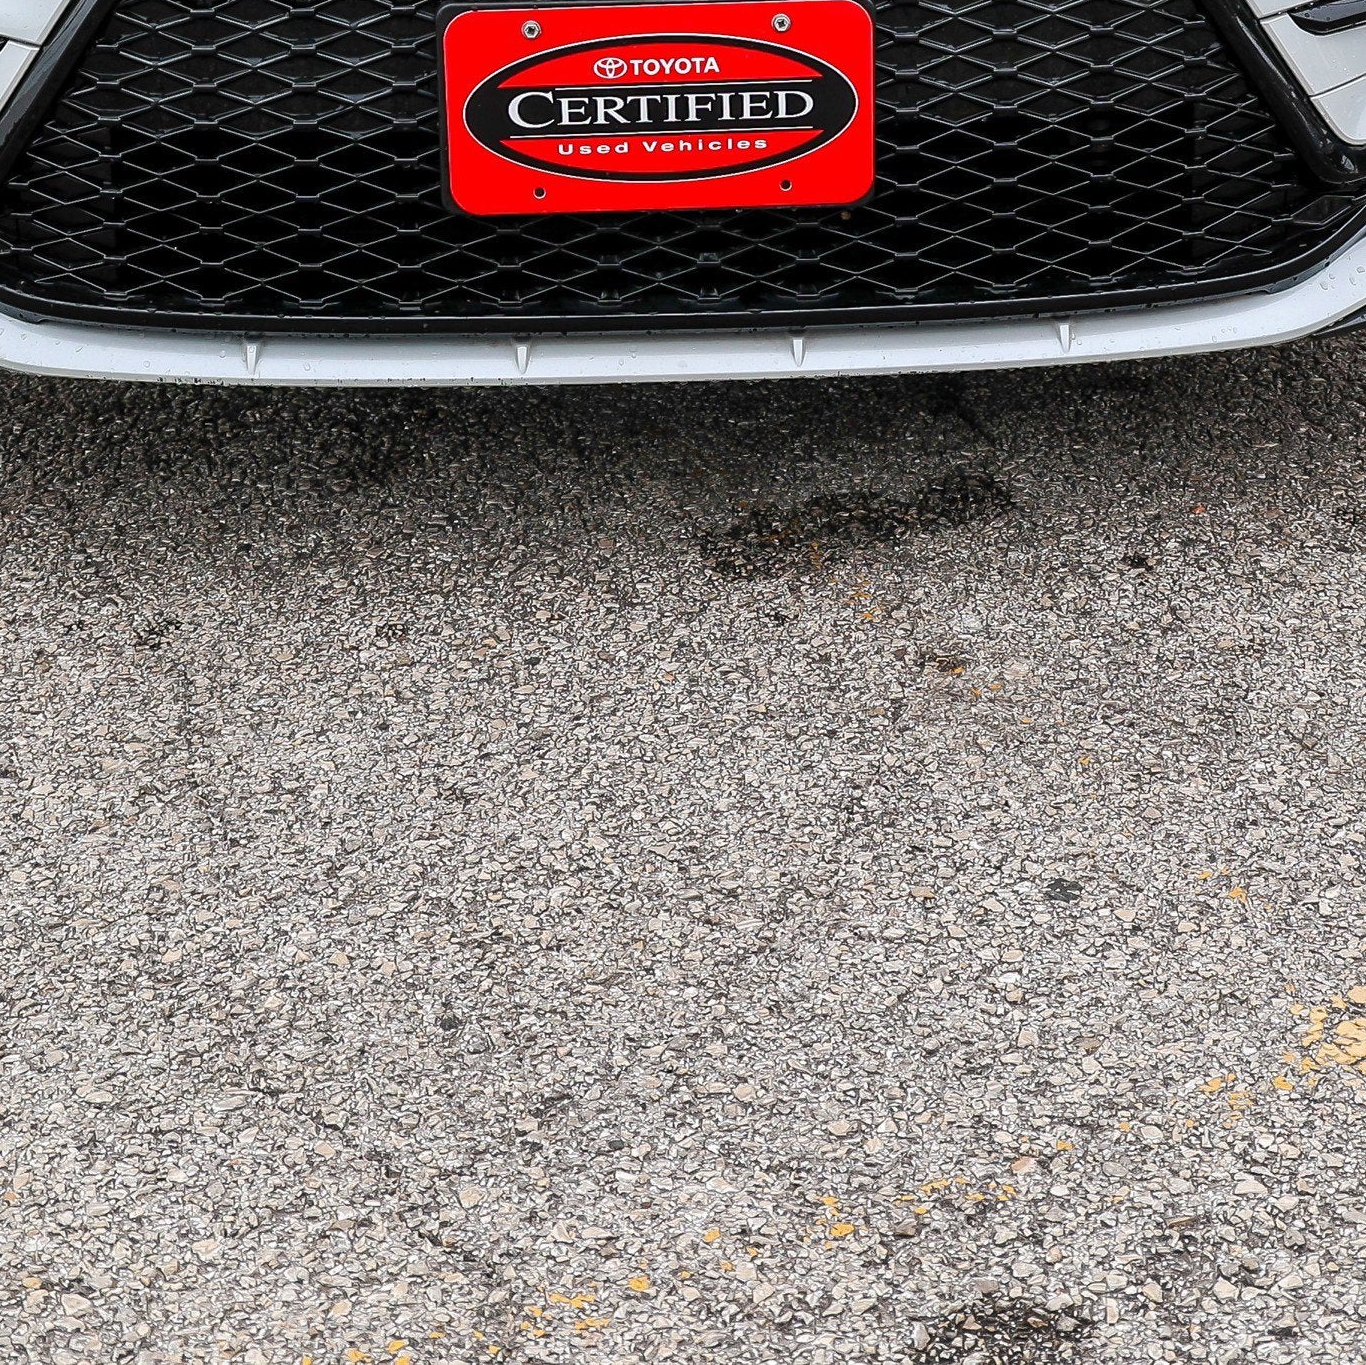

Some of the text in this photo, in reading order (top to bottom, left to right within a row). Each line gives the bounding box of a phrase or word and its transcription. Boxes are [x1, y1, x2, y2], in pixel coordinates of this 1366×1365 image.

[630, 57, 720, 76] TOYOTA
[508, 91, 814, 128] CERTIFIED
[558, 138, 768, 156] Used Vehicles
